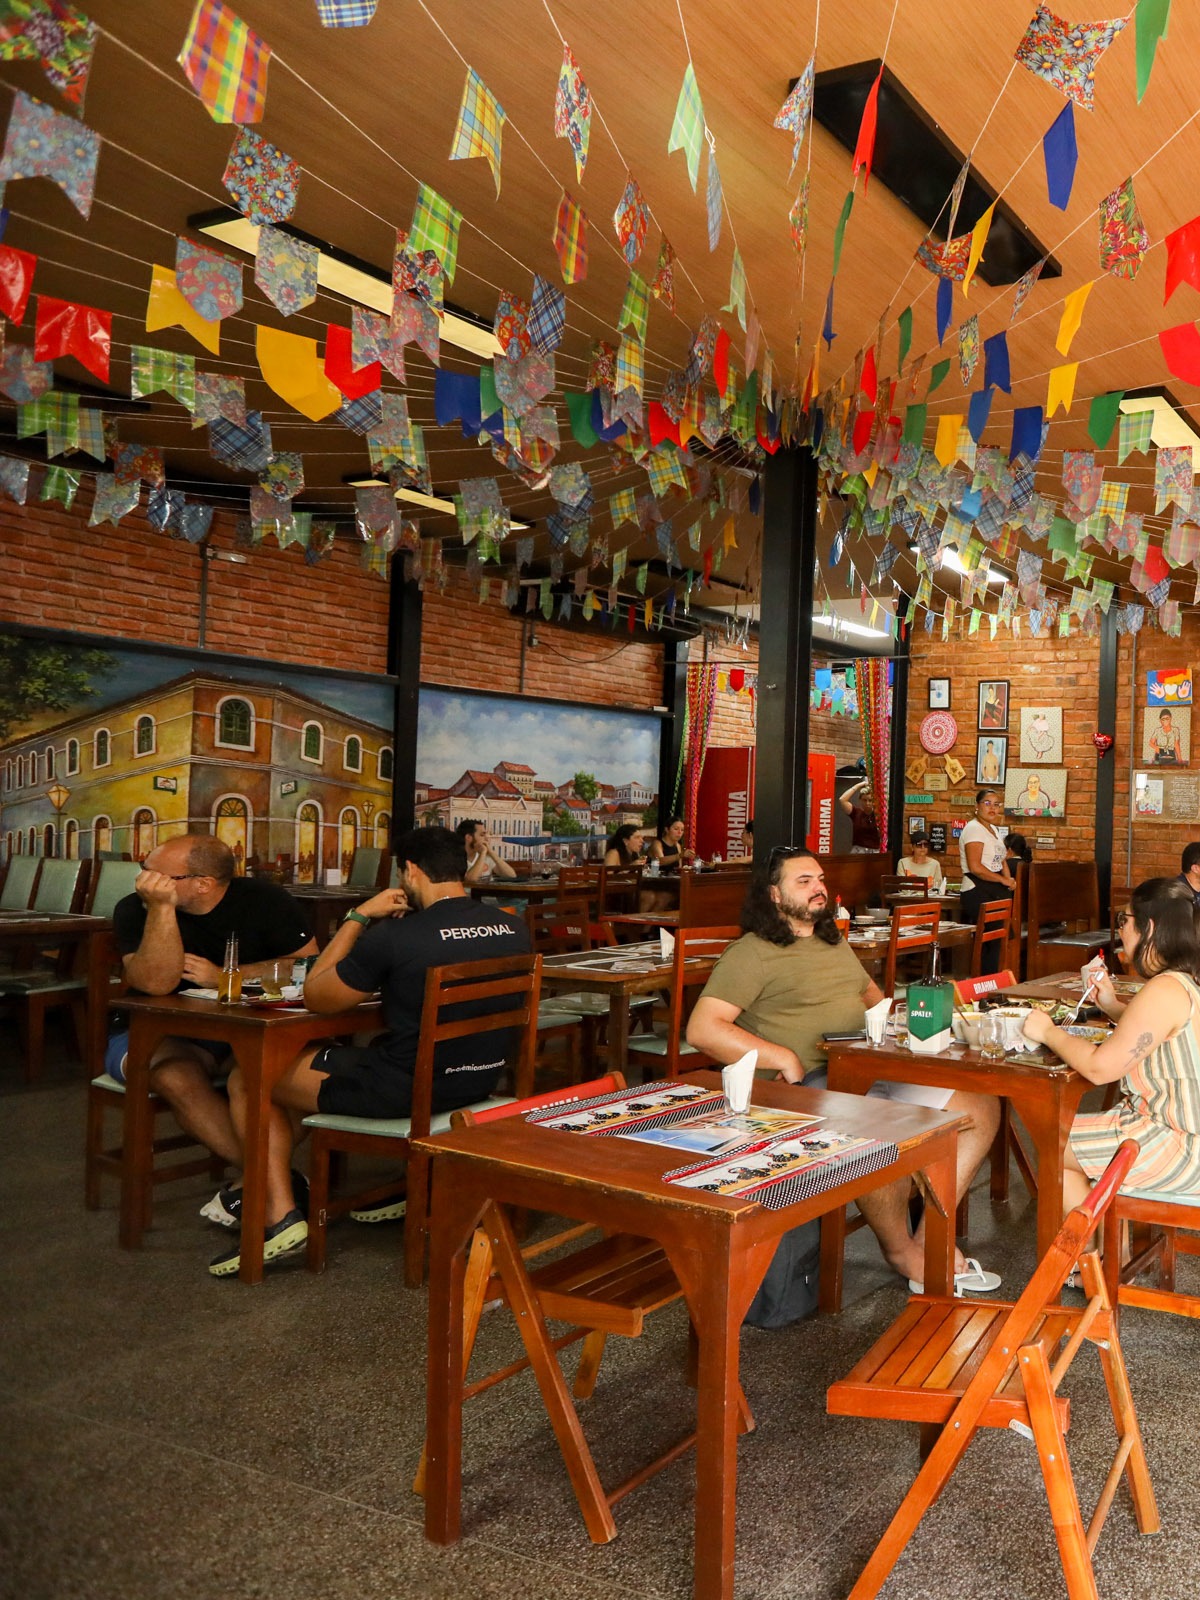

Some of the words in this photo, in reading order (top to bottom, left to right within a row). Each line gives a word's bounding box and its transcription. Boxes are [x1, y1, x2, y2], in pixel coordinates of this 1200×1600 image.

[727, 790, 747, 860] BRAHMA
[818, 798, 832, 854] BRAHMA
[440, 924, 515, 940] PERSONAL
